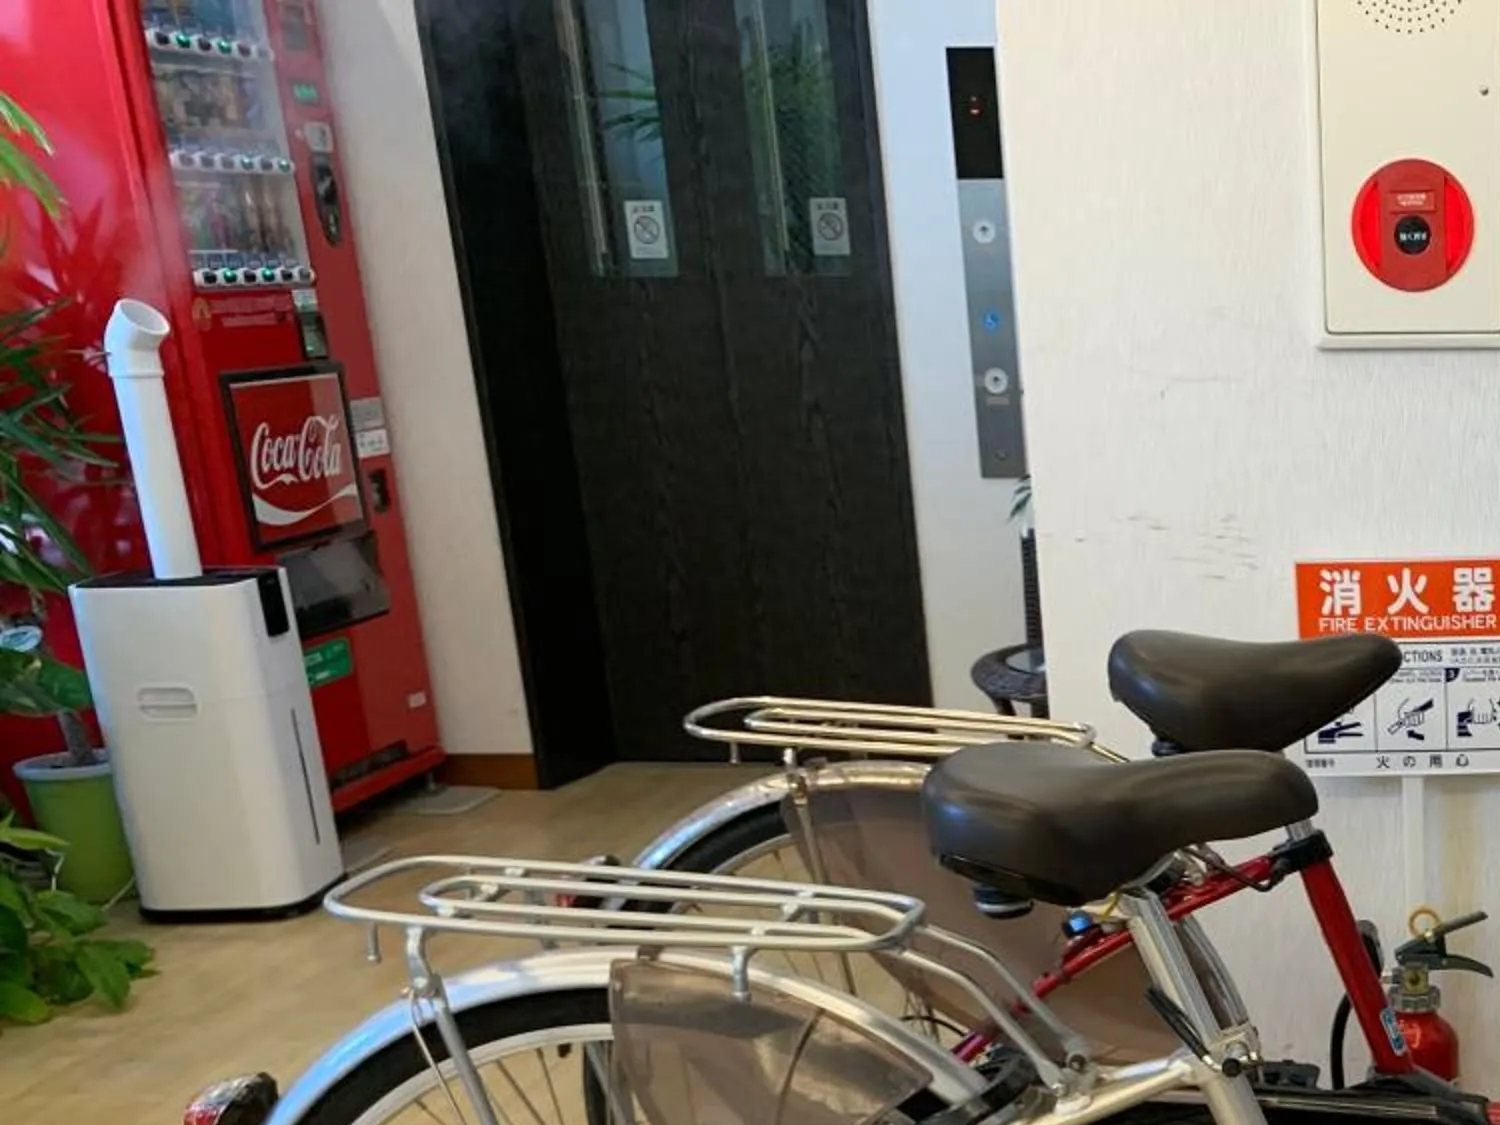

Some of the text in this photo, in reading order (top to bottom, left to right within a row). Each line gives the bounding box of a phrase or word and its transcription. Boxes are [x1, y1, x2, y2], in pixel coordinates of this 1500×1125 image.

[251, 415, 341, 489] Coca-Cola
[1319, 567, 1495, 615] 消火器
[1318, 614, 1497, 632] FIRE EXTINGUISHER
[1403, 649, 1443, 663] CTIONS
[1375, 753, 1470, 769] 火の用心
